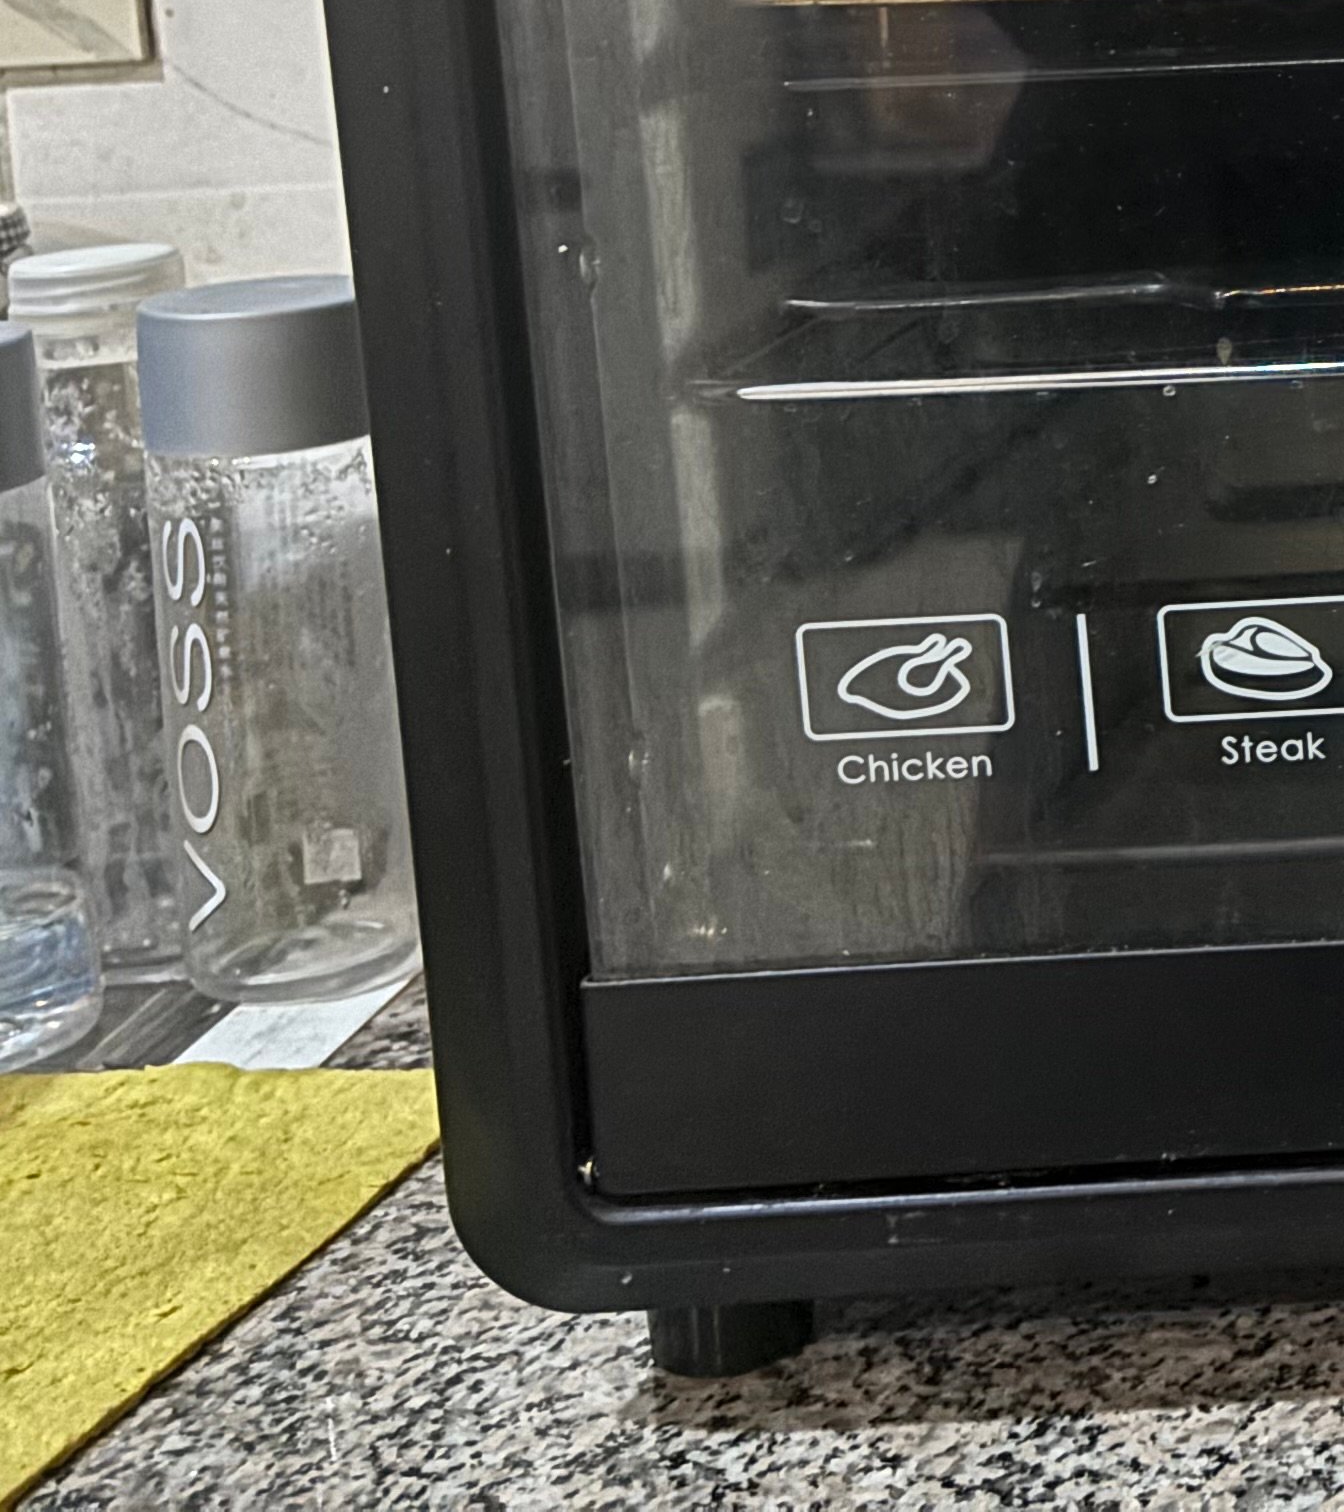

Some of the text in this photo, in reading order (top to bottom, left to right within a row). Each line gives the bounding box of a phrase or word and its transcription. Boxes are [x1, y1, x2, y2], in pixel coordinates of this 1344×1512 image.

[161, 518, 226, 932] VOSS
[1221, 731, 1326, 765] Steak
[837, 751, 993, 785] Chicken
